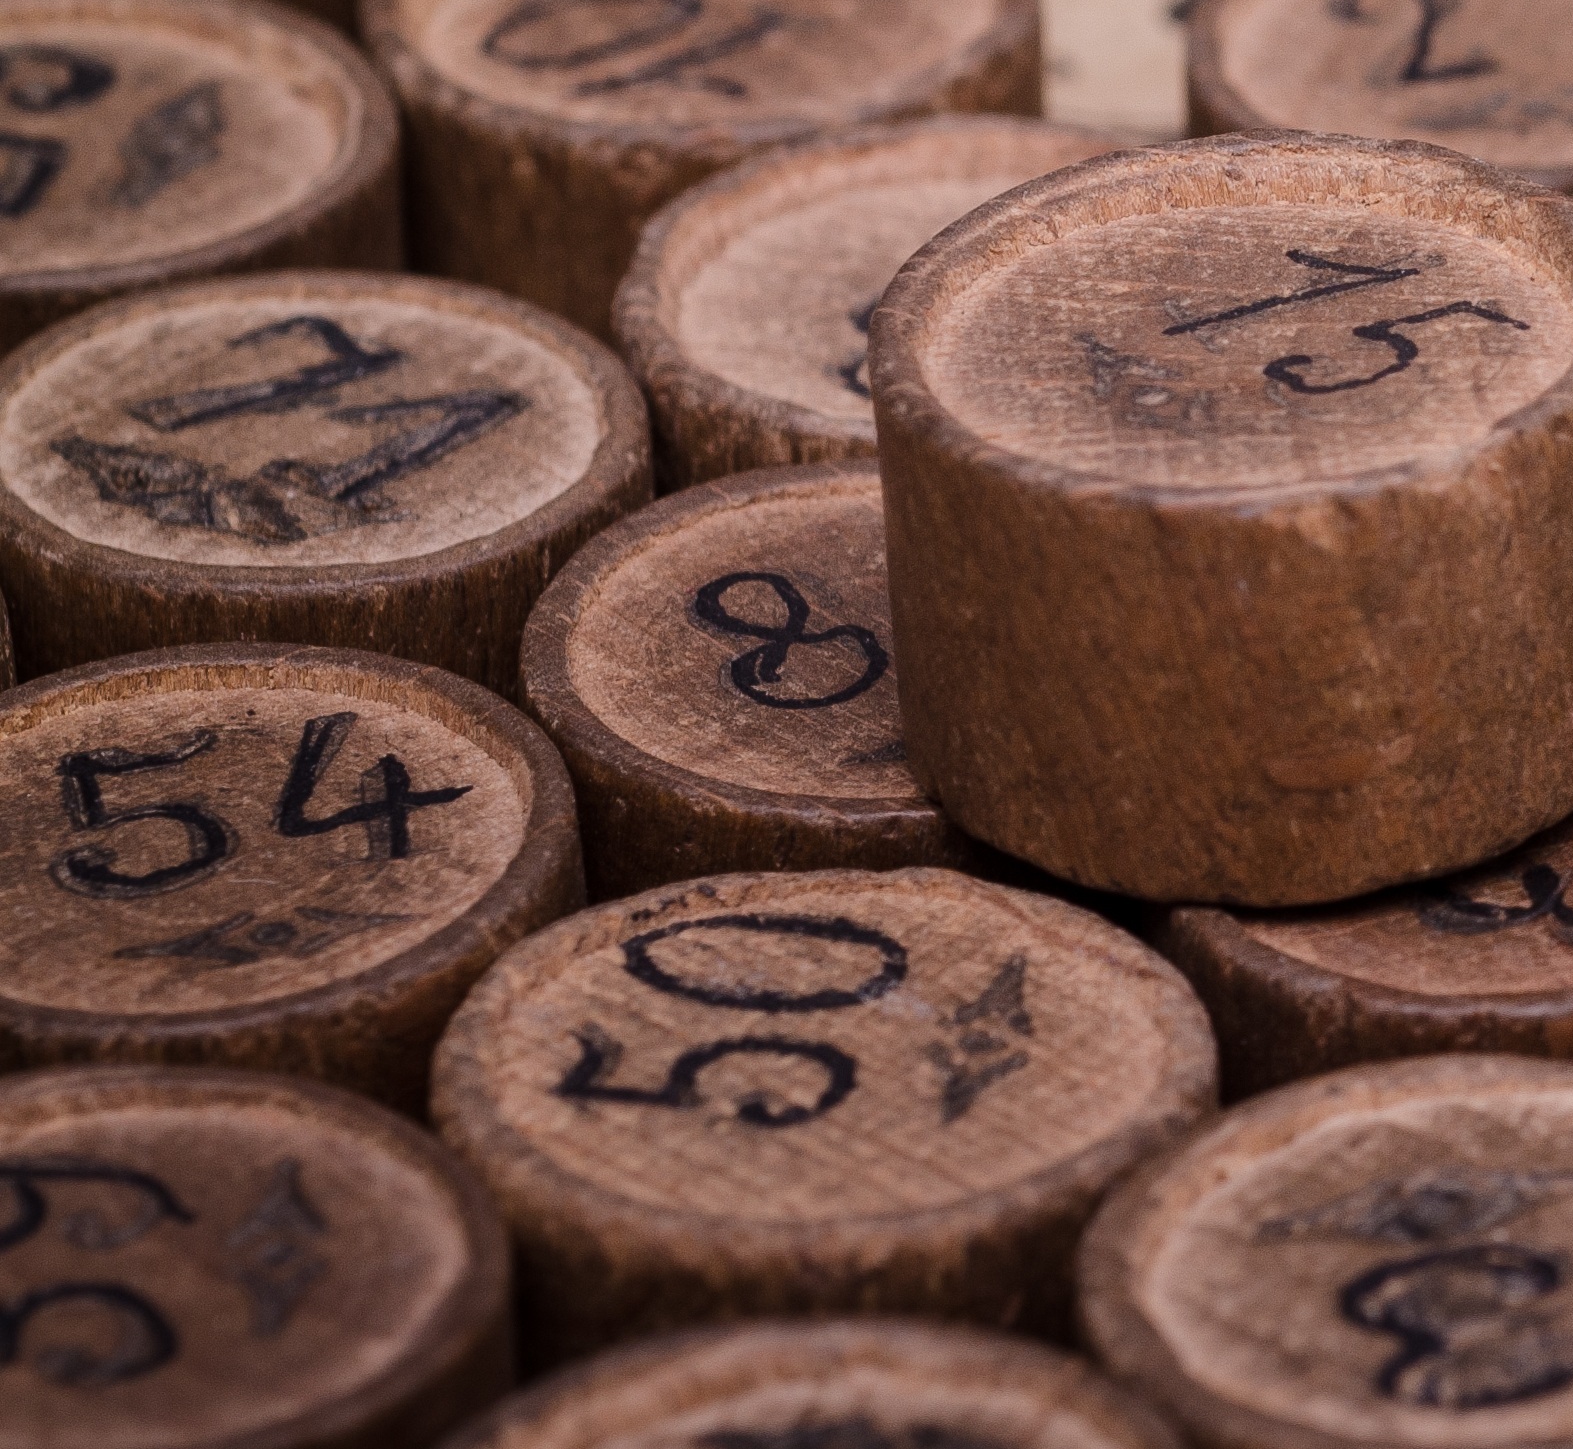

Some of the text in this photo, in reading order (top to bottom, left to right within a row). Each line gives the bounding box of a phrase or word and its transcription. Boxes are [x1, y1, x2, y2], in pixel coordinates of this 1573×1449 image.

[1162, 247, 1532, 395] 15
[686, 570, 892, 710] 8
[52, 710, 475, 899] 54
[554, 909, 908, 1129] 50
